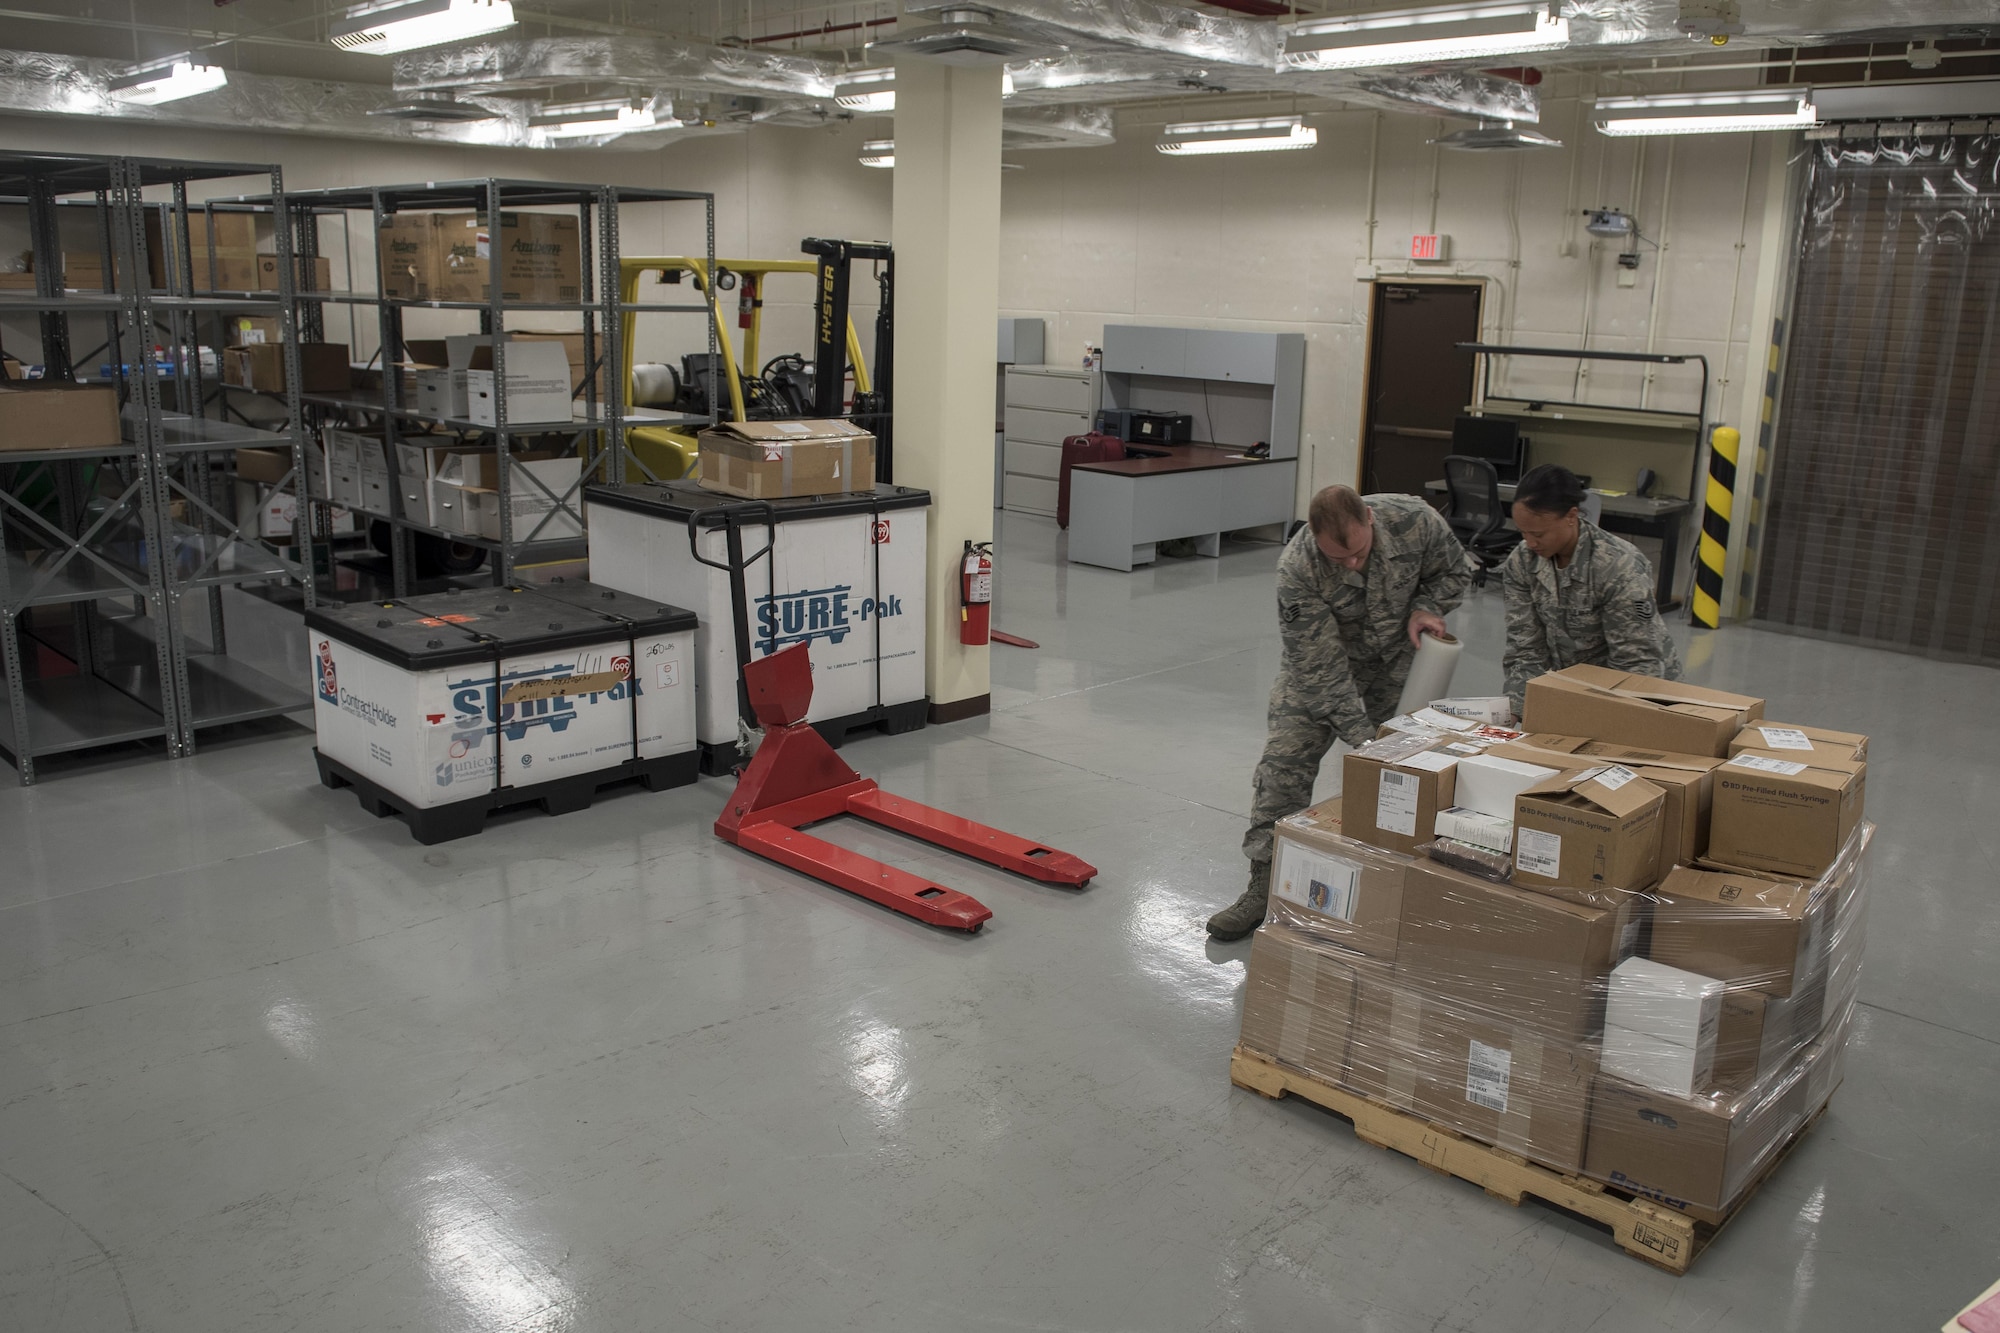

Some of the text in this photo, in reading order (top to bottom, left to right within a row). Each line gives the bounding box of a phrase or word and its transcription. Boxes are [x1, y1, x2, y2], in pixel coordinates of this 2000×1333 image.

[1412, 235, 1437, 258] EXIT
[822, 264, 835, 344] HYSTER
[340, 687, 371, 716] Contract
[372, 702, 397, 728] Holder
[594, 735, 663, 753] WWW.SUREPAKPAAGING.COM
[1730, 782, 1741, 790] BD
[1742, 784, 1777, 797] Pre-Filled
[1778, 789, 1798, 800] Flush
[1800, 793, 1830, 805] Syringe
[1526, 807, 1612, 833] BD Pre-Filled Flush Syringe
[1610, 1170, 1693, 1210] Baxter
